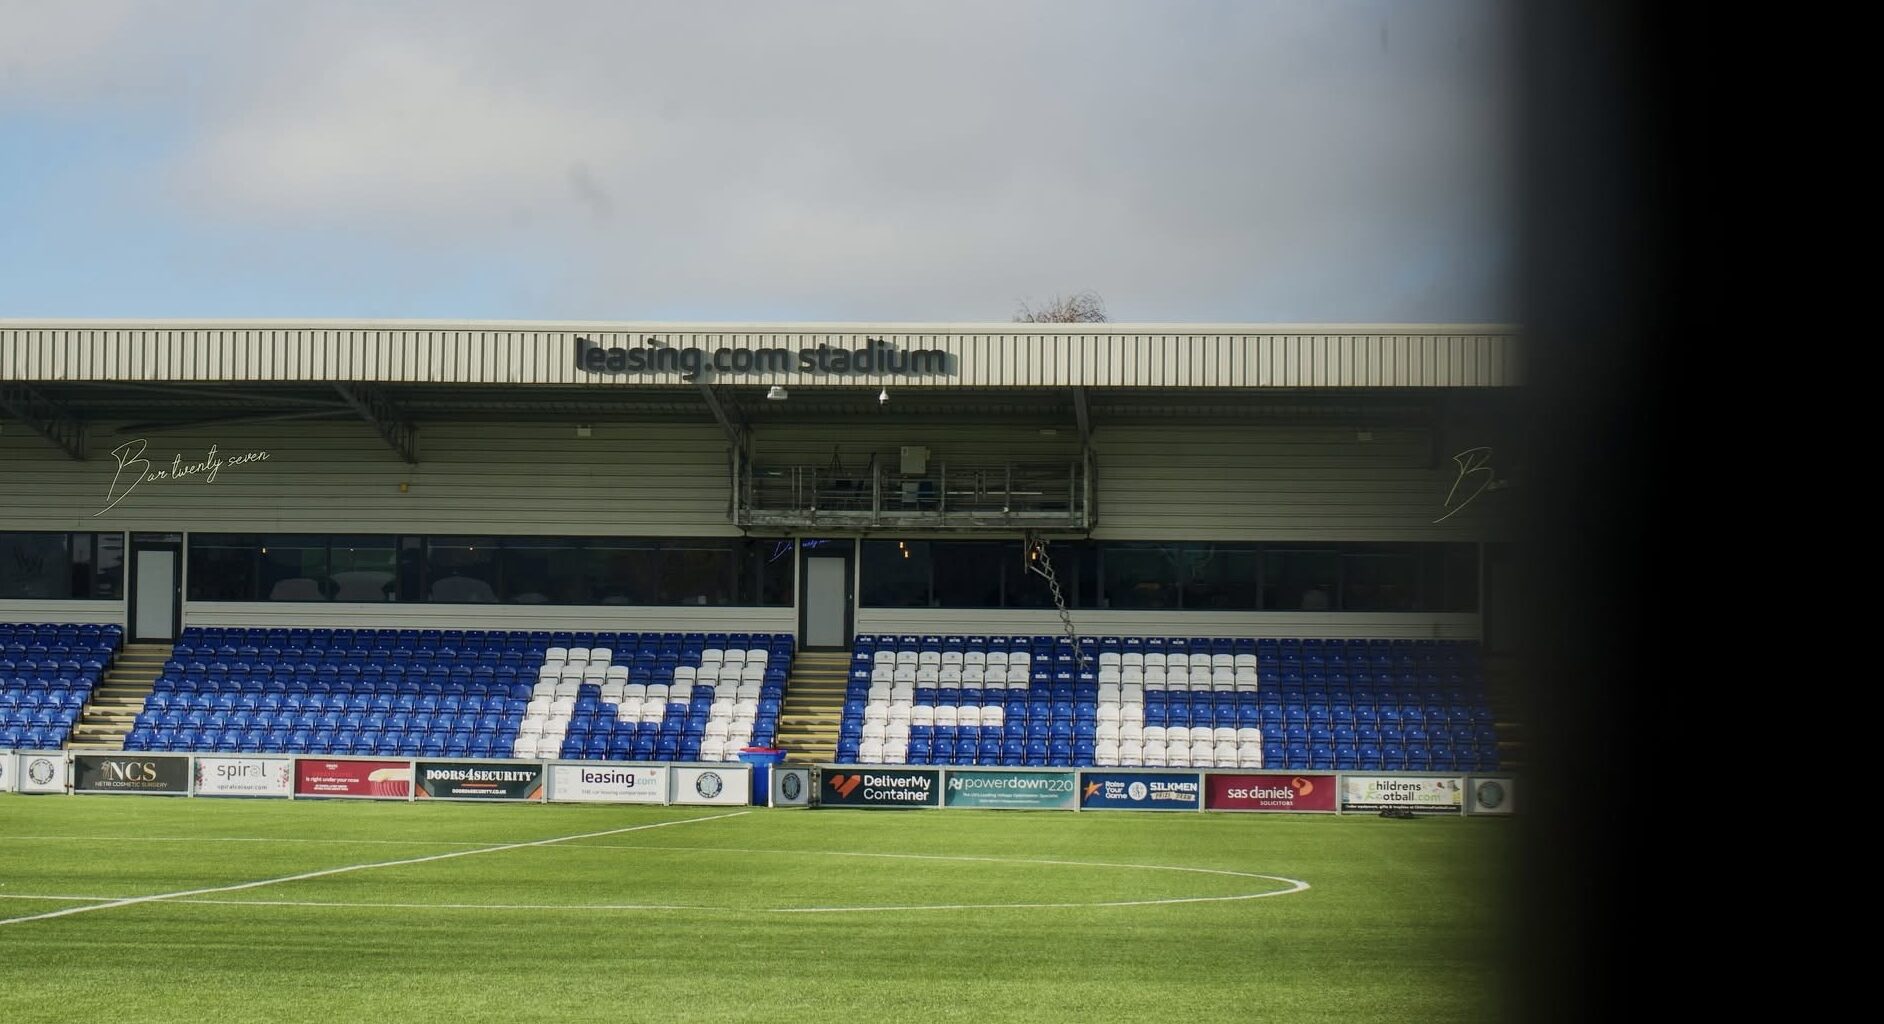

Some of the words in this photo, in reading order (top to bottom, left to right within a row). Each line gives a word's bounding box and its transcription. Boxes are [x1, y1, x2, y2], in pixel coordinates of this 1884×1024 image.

[576, 337, 789, 380] leasing.com
[799, 337, 945, 373] stadium
[93, 438, 168, 517] Bar
[172, 444, 223, 483] twenty
[228, 450, 271, 467] seven
[109, 761, 157, 782] NCS
[864, 774, 931, 790] DeliverMy
[1150, 782, 1198, 791] SILKMEN
[863, 788, 929, 801] Container
[1228, 788, 1248, 799] sas
[1249, 786, 1294, 799] daniels
